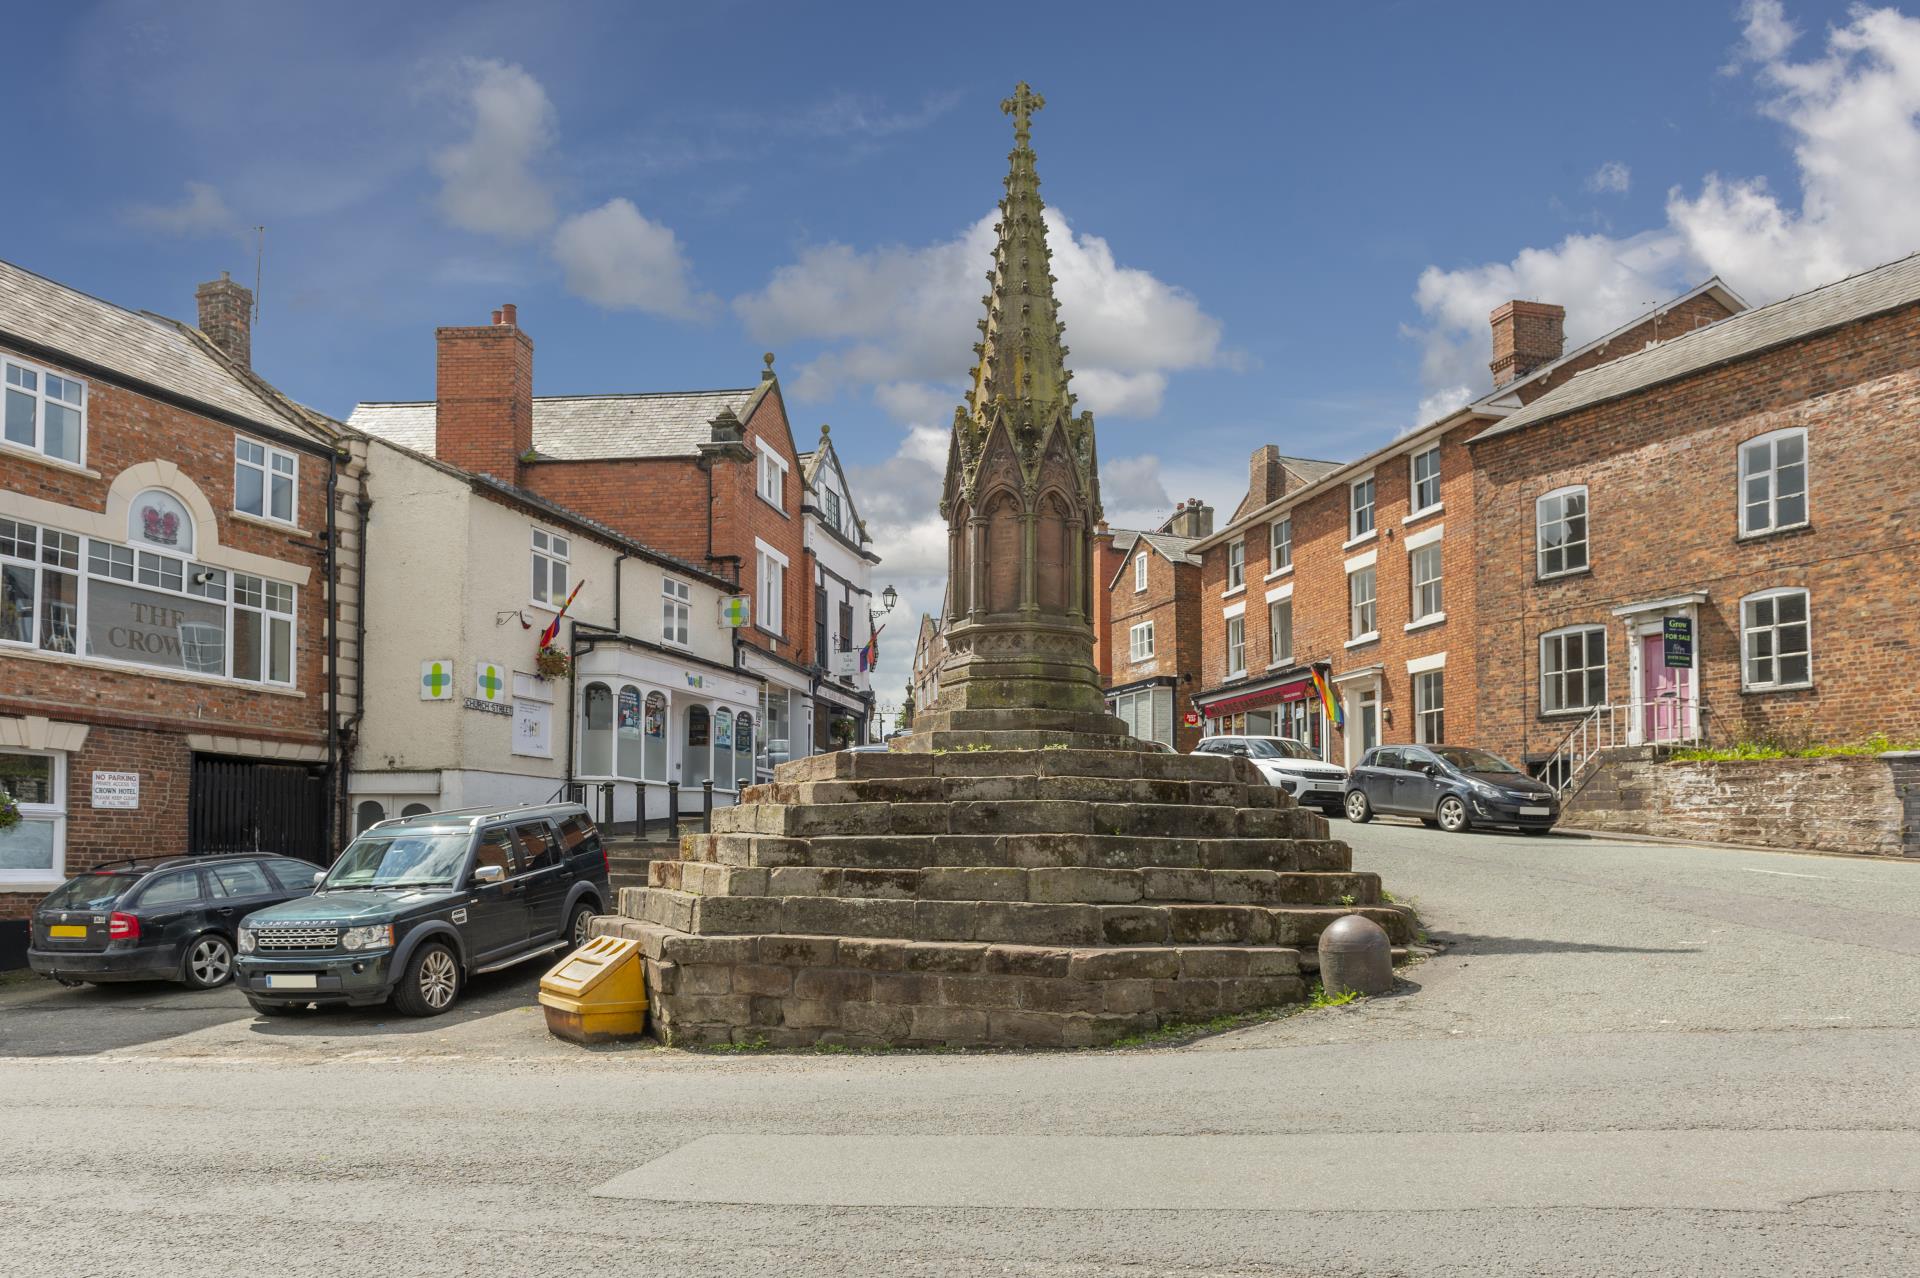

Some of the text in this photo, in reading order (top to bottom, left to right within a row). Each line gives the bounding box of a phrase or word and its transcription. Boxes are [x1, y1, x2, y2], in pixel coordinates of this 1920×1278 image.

[130, 602, 184, 629] THE
[108, 627, 203, 659] CROWN
[108, 774, 137, 782] PARKING
